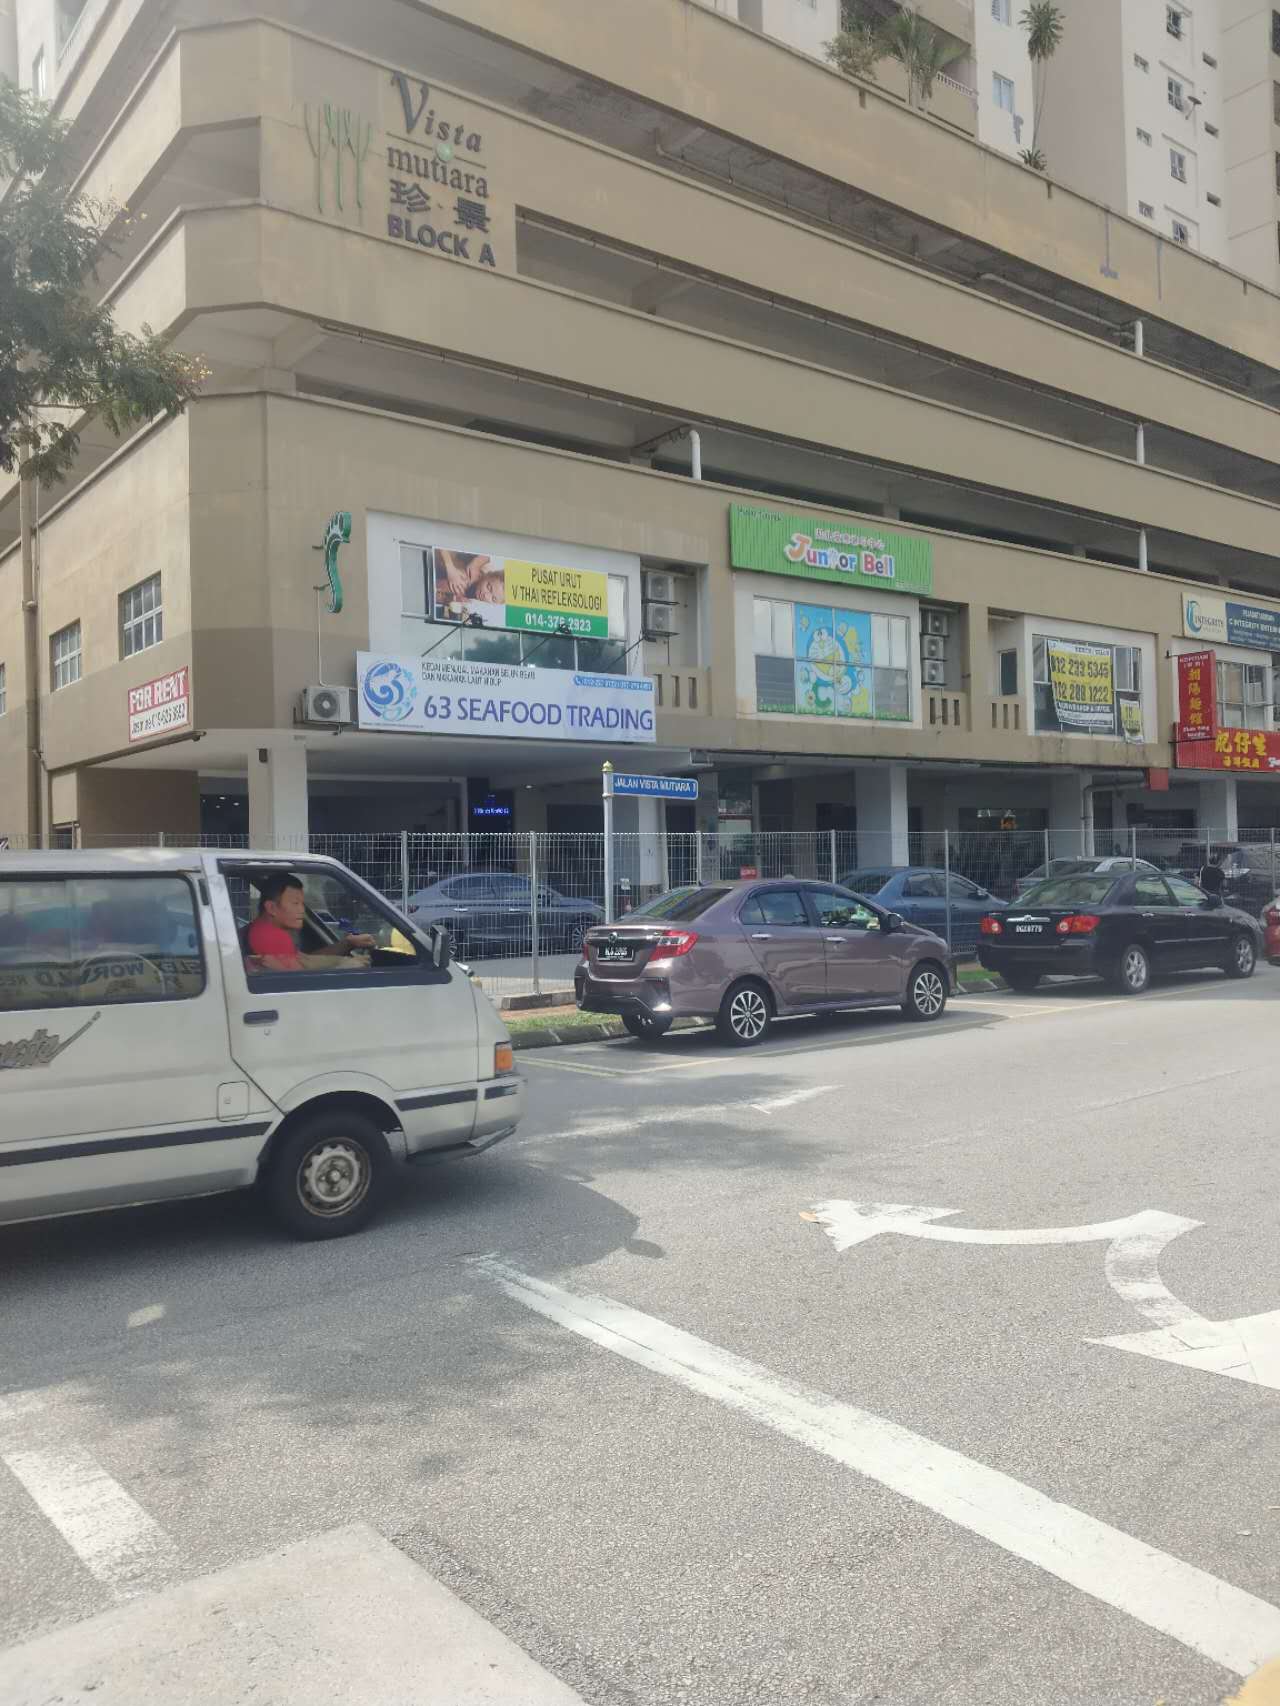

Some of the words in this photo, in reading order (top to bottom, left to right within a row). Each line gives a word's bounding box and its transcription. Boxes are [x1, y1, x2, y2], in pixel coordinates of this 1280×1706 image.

[390, 70, 482, 153] Vista
[387, 146, 489, 199] mutiara
[387, 214, 470, 259] BLOCK
[479, 243, 496, 267] A
[784, 533, 858, 572] Junior
[862, 551, 895, 578] Bell
[519, 586, 540, 603] THAI
[541, 589, 602, 611] REFLEKSOLOGI
[531, 567, 558, 585] PUSAT
[559, 572, 582, 589] URUT
[130, 685, 152, 714] FOR
[154, 670, 187, 705] RENT
[424, 696, 452, 719] 63
[457, 698, 562, 725] SEAFOOD
[566, 704, 653, 731] TRADING
[615, 777, 638, 789] JALAN
[640, 779, 660, 790] VISTA
[660, 781, 690, 792] MUTIARA
